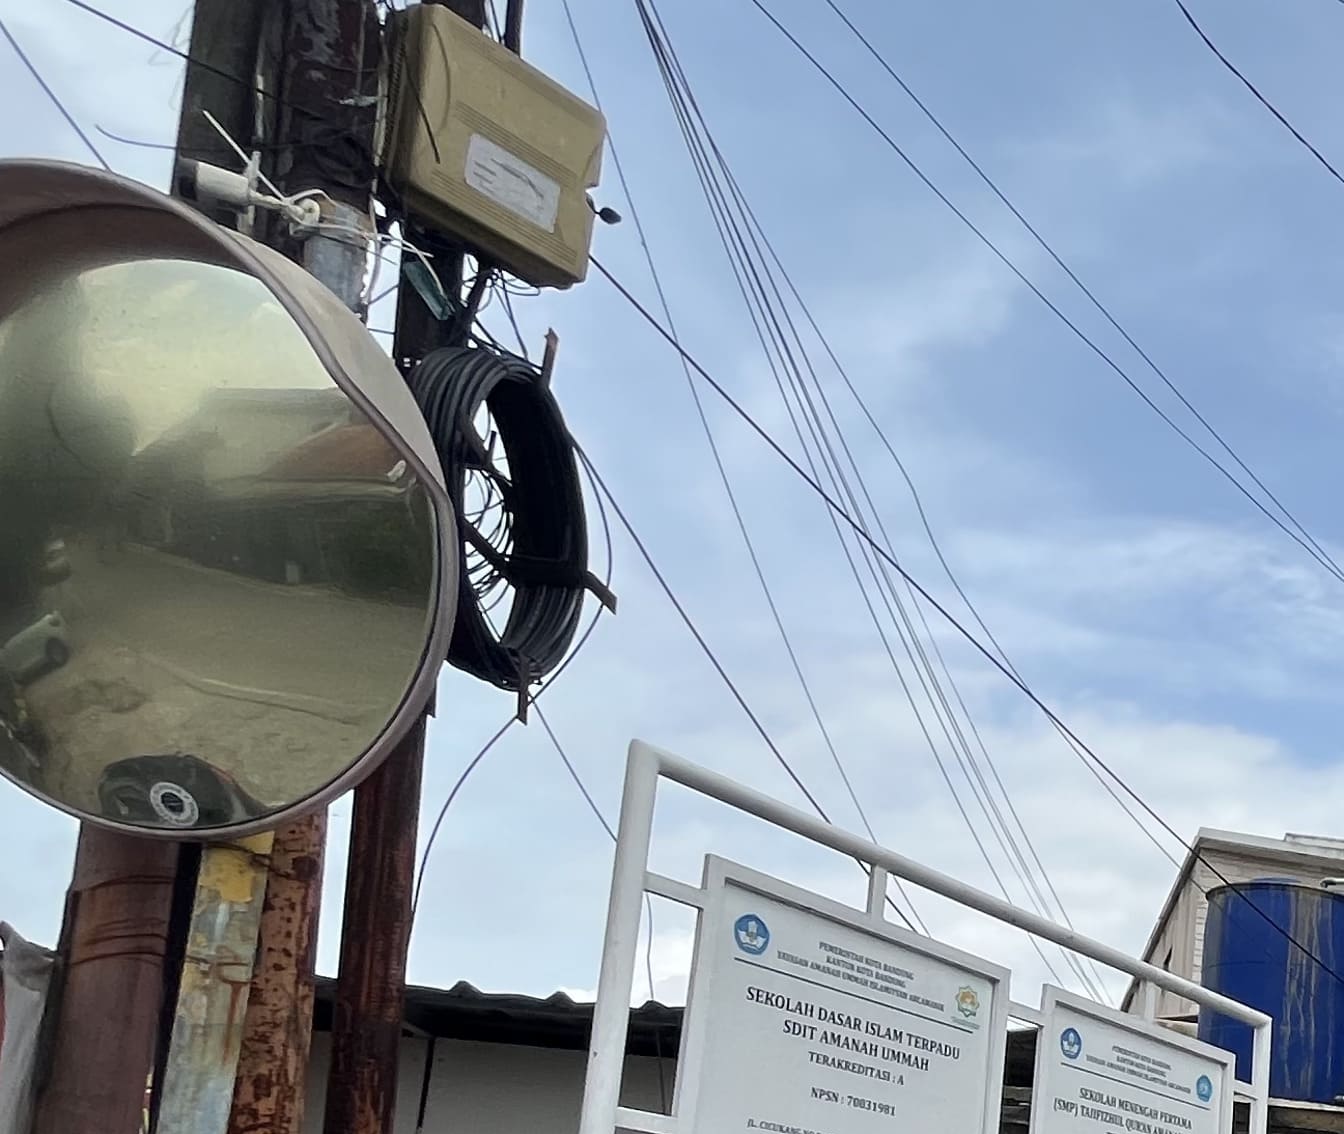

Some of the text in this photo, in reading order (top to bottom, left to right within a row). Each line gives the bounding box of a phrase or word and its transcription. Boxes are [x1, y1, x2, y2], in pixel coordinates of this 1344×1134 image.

[747, 986, 960, 1059] SEKOLAH DASAR ISLAM TERPADU
[783, 1019, 929, 1071] SDIT AMANAH UMMAH
[808, 1052, 891, 1082] TERAKREDITASI
[897, 1075, 904, 1085] A
[811, 1087, 839, 1103] NPSN
[1079, 1088, 1116, 1107] SEKOLAH
